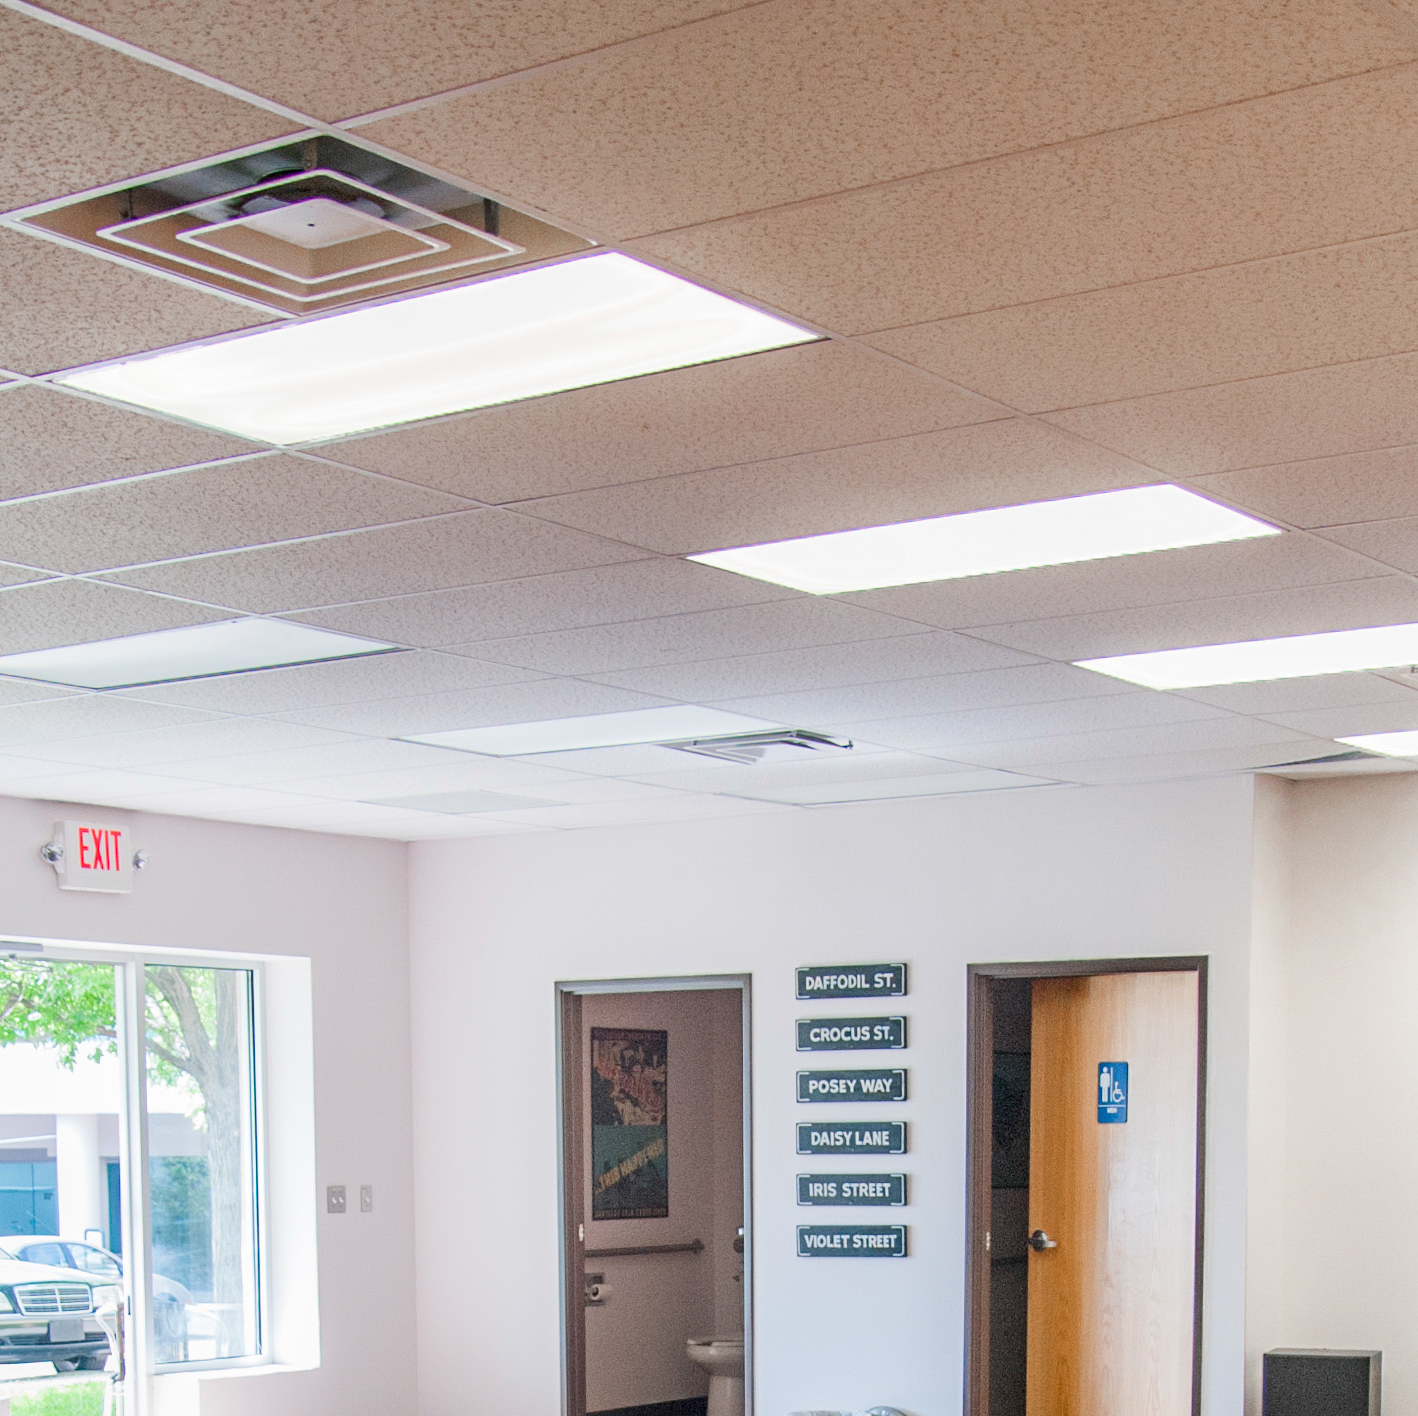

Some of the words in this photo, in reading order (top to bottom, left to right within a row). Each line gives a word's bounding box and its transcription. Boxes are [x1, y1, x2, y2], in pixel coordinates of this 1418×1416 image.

[78, 827, 122, 871] EXIT
[805, 974, 870, 991] DAFFODIL
[874, 972, 897, 988] ST.
[809, 1026, 871, 1043] CROCUS
[873, 1025, 895, 1041] ST.
[808, 1079, 857, 1094] POSEY
[859, 1078, 894, 1093] WAY
[810, 1131, 853, 1146] DAISY
[854, 1130, 890, 1146] LANE
[808, 1182, 837, 1198] IRIS
[841, 1182, 891, 1198] STREET
[804, 1234, 850, 1249] VIOLET
[852, 1234, 898, 1249] STREET
